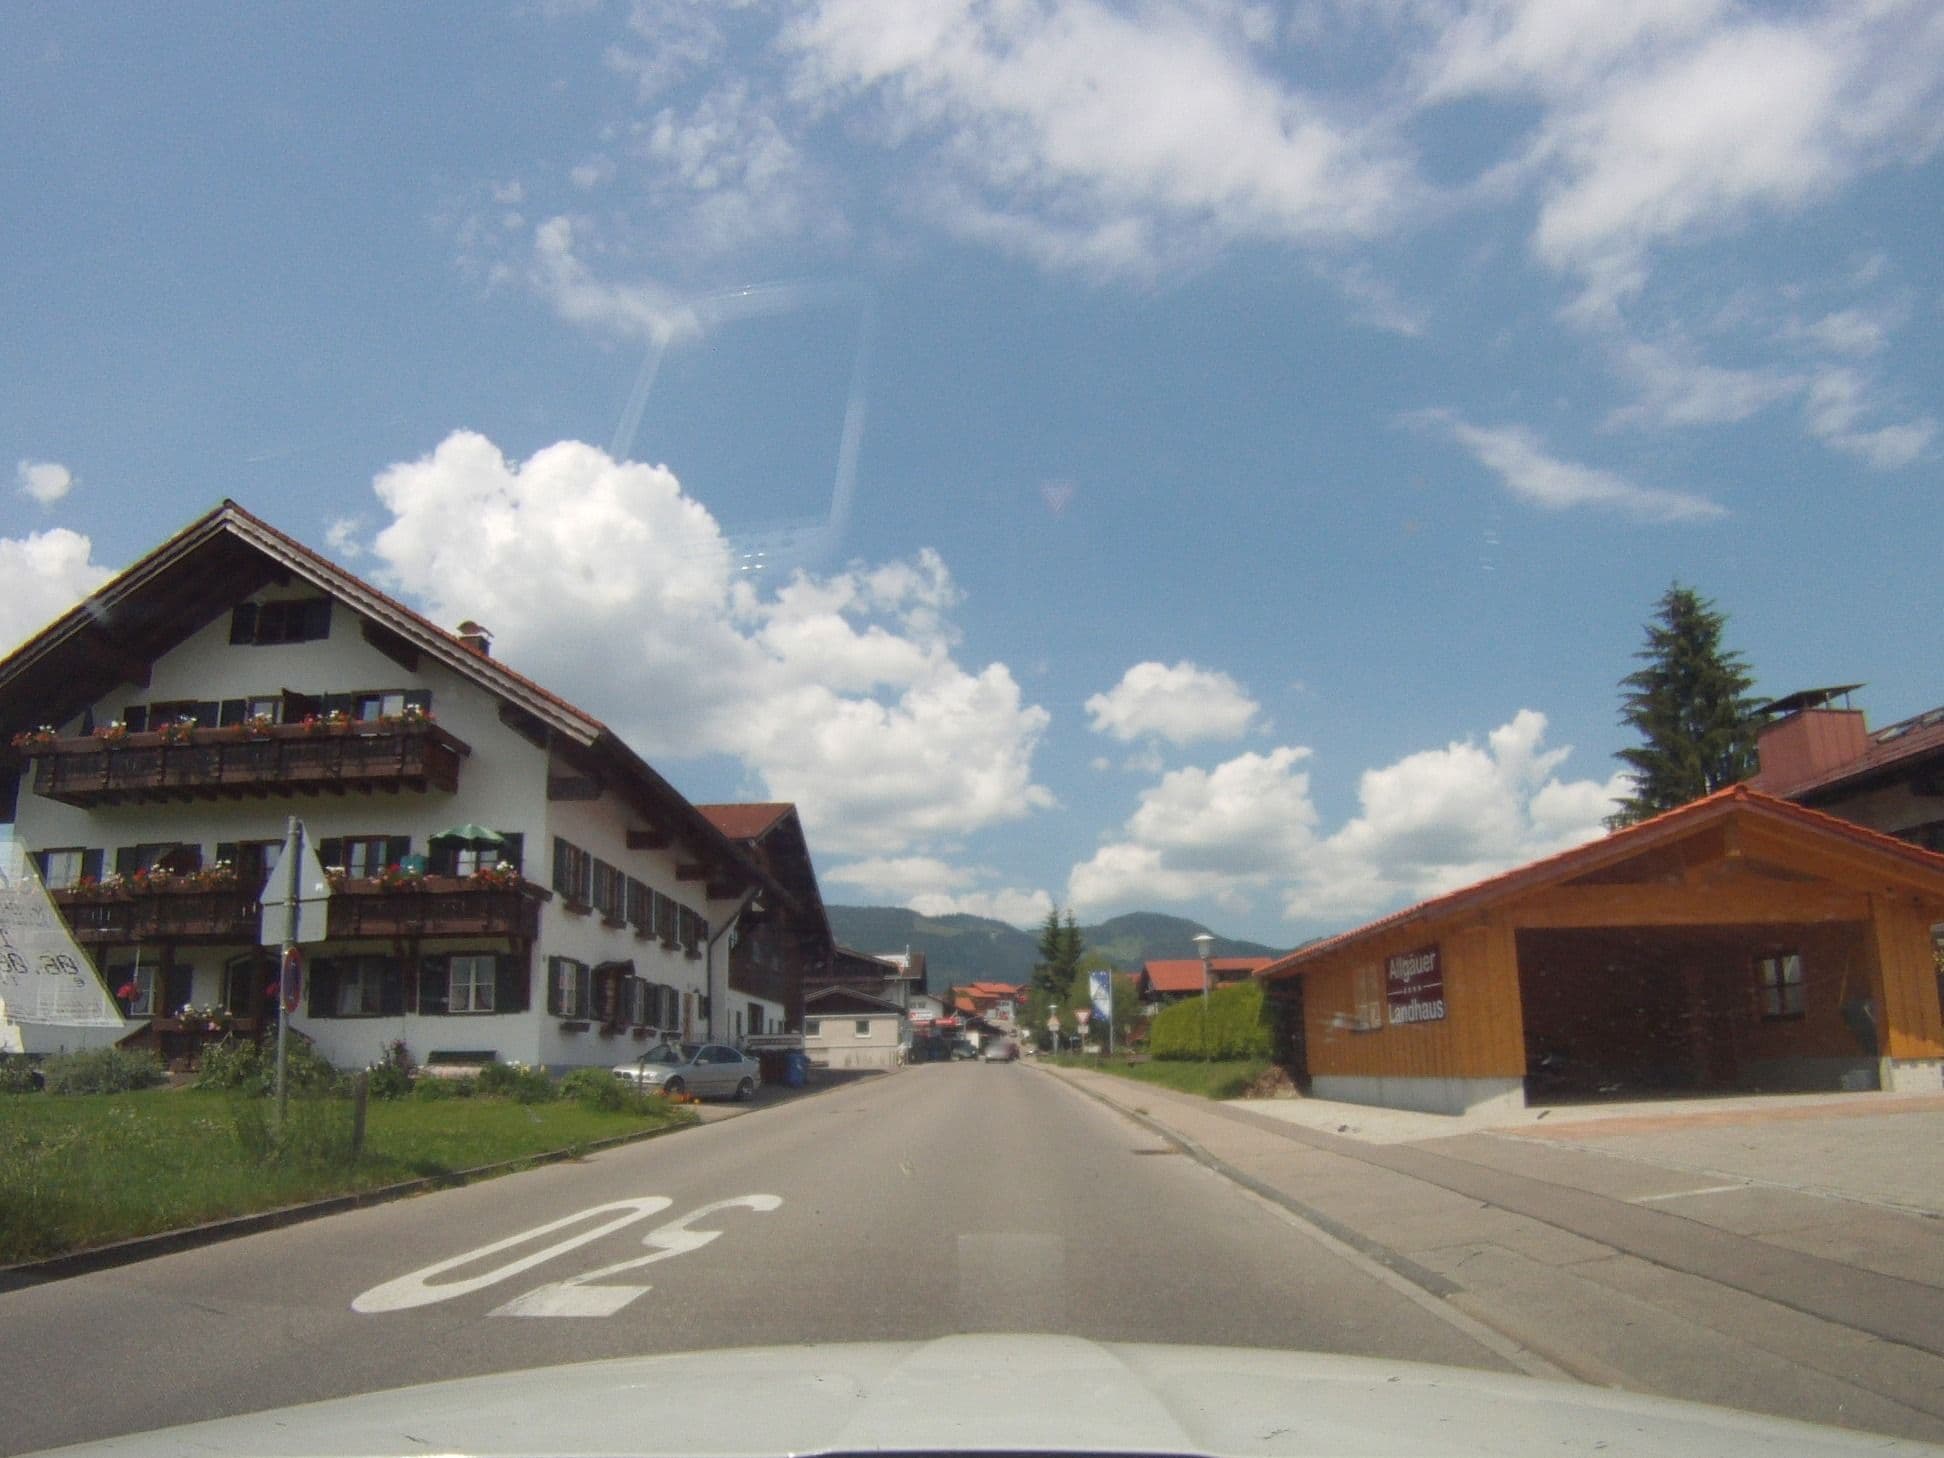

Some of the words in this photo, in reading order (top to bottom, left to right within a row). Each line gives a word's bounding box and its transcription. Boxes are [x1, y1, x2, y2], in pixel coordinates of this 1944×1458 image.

[1390, 953, 1436, 983] Allgäuer
[1388, 998, 1444, 1024] Landhaus
[351, 1194, 783, 1318] 30
